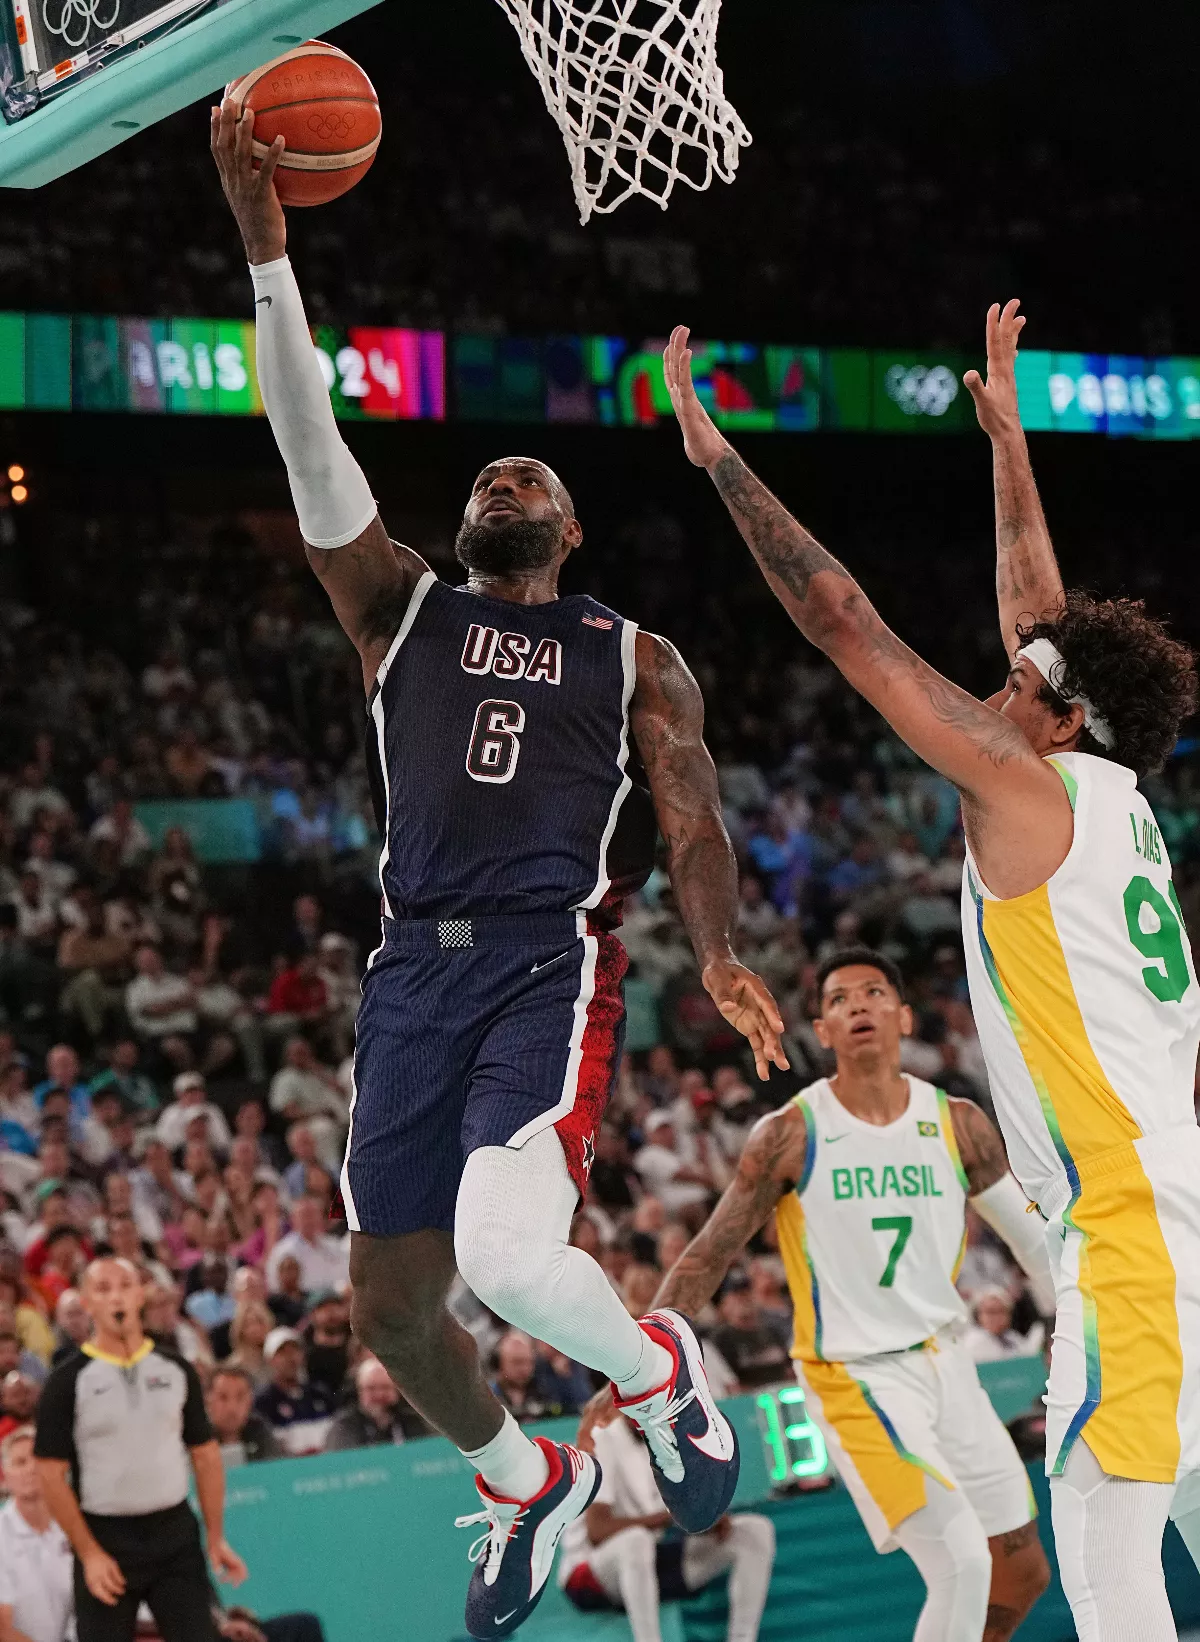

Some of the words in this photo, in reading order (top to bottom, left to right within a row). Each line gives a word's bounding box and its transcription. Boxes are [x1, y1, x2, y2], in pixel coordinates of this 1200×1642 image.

[271, 70, 323, 93] PARIS
[1048, 373, 1172, 420] PARIS
[460, 623, 563, 686] USA
[465, 698, 526, 784] 6
[832, 1165, 943, 1201] BRASIL
[871, 1216, 913, 1287] 7
